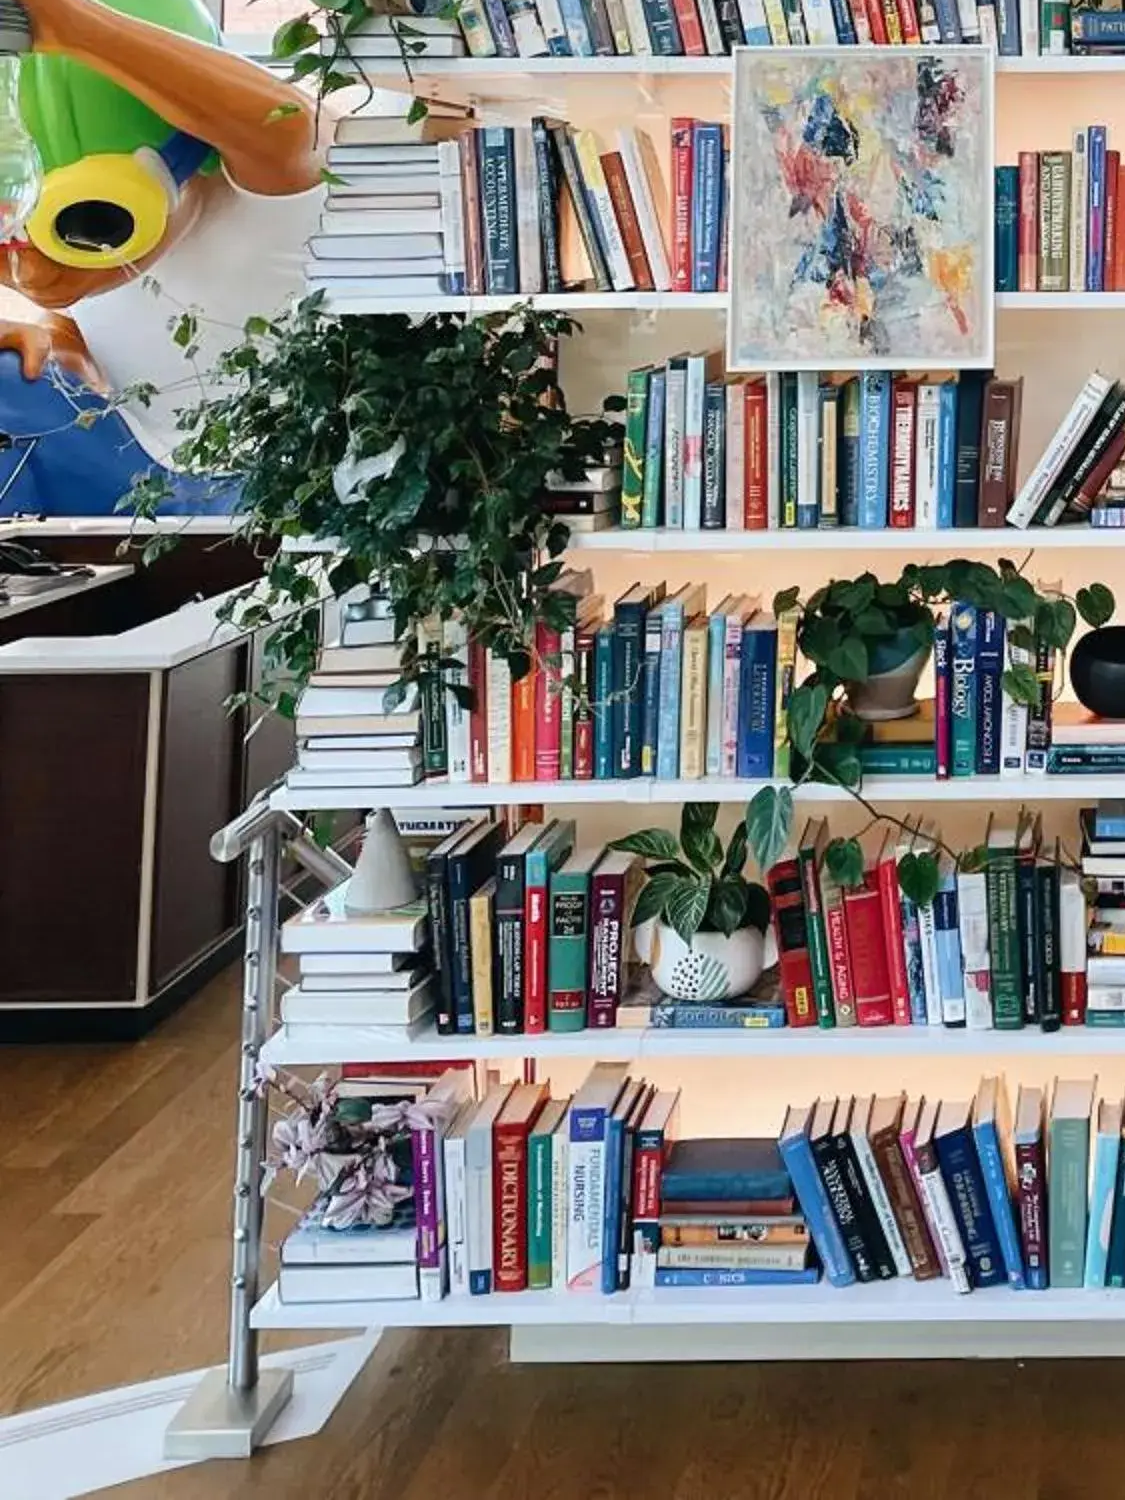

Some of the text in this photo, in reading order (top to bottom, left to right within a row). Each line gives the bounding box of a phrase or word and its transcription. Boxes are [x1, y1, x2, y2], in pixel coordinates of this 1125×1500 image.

[485, 157, 498, 240] ACCOUNTING
[497, 155, 510, 251] INTERMEDIATE
[1042, 165, 1051, 191] AND
[1052, 164, 1063, 259] CABINETMAKING
[865, 395, 882, 501] BIOCHEMISTRY
[893, 406, 913, 511] THERMODYNAMICS
[952, 658, 974, 717] Biology
[599, 918, 609, 996] MANAGEMENT
[609, 921, 618, 994] PROJECT
[830, 911, 843, 949] HEALTH
[836, 965, 848, 999] AGING
[501, 1162, 518, 1269] DICTIONARY
[574, 1165, 585, 1222] NURSING
[588, 1148, 601, 1249] FUNDAMENTALS
